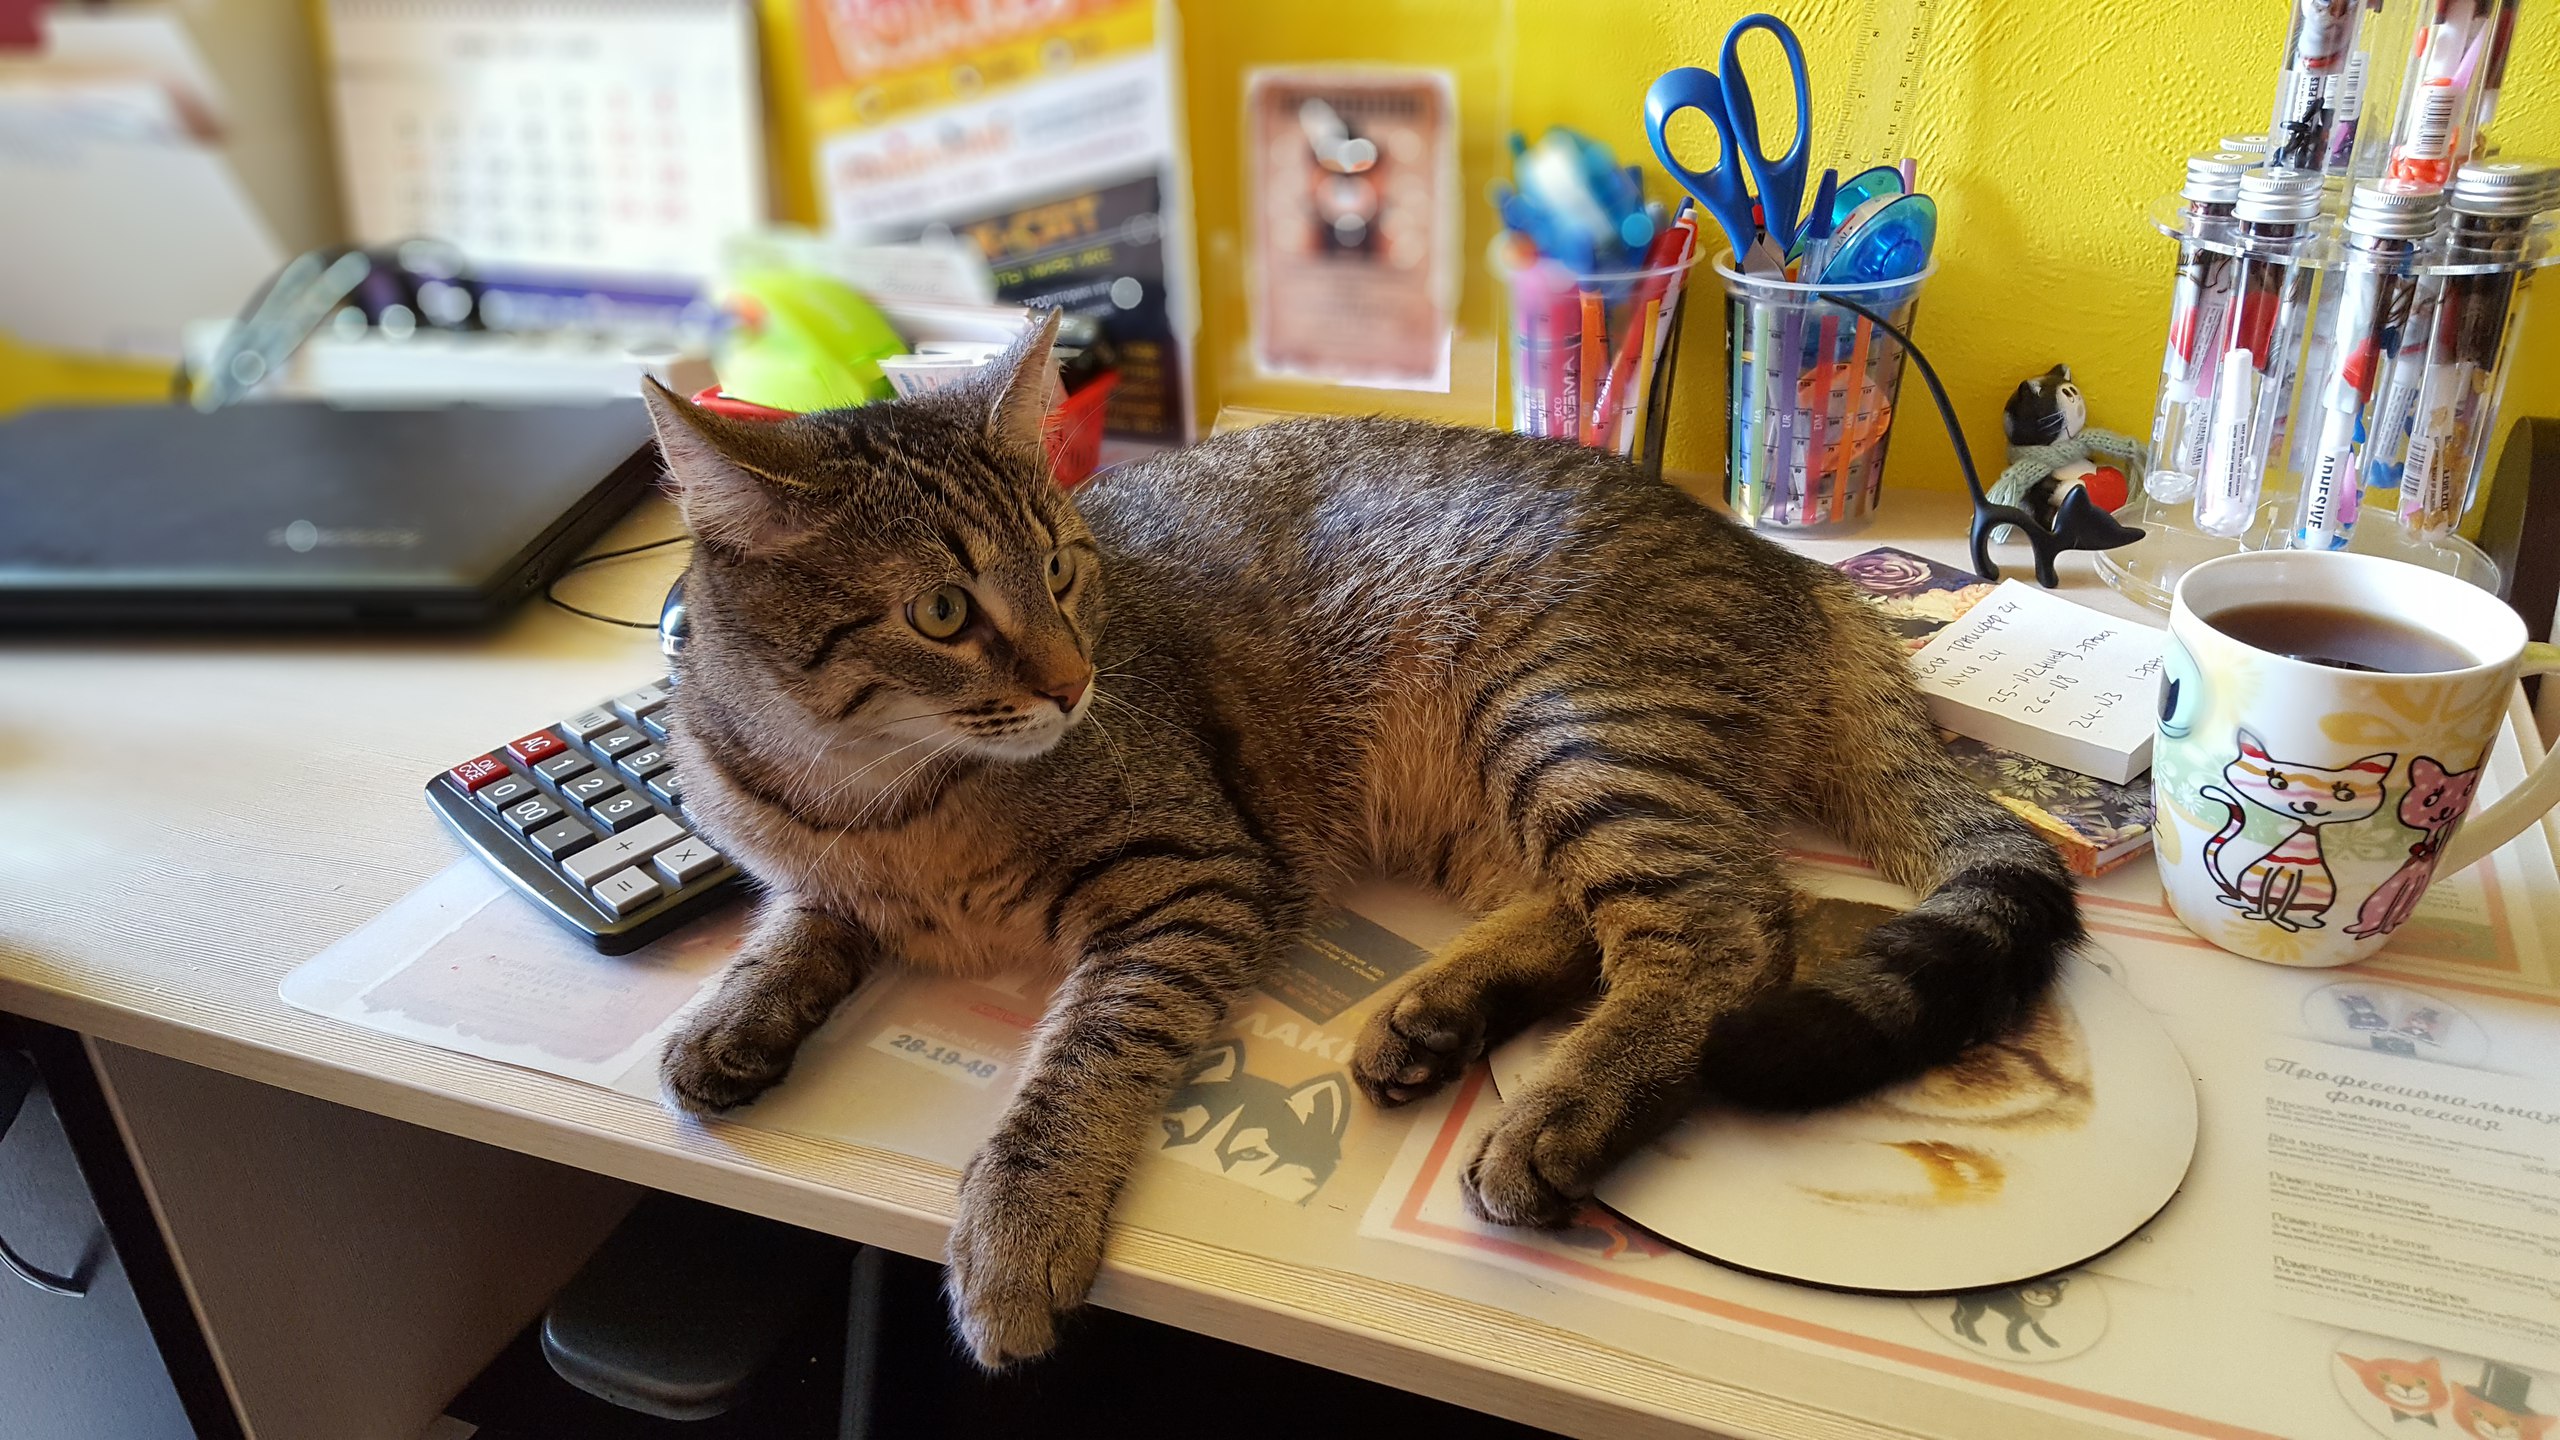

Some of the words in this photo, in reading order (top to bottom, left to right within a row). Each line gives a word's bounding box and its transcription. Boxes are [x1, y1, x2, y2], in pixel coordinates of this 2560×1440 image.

[1912, 27, 1920, 39] 10
[1906, 52, 1914, 63] 11
[1900, 76, 1908, 88] 12
[1894, 100, 1903, 112] 13
[1888, 124, 1896, 135] 14
[1882, 148, 1890, 159] 15
[2308, 455, 2335, 529] ADHESIVE
[575, 712, 606, 729] MU
[520, 736, 551, 752] AC
[608, 735, 630, 748] 4
[478, 759, 497, 772] ON
[552, 759, 575, 771] 1
[634, 751, 661, 767] 5
[493, 783, 517, 797] 0
[577, 778, 604, 793] 2
[516, 801, 548, 821] 00
[608, 799, 633, 813] 3
[889, 1034, 998, 1078] 28-19-48
[2265, 1058, 2560, 1126] Профессиональная
[2325, 1089, 2504, 1132] фотосессия
